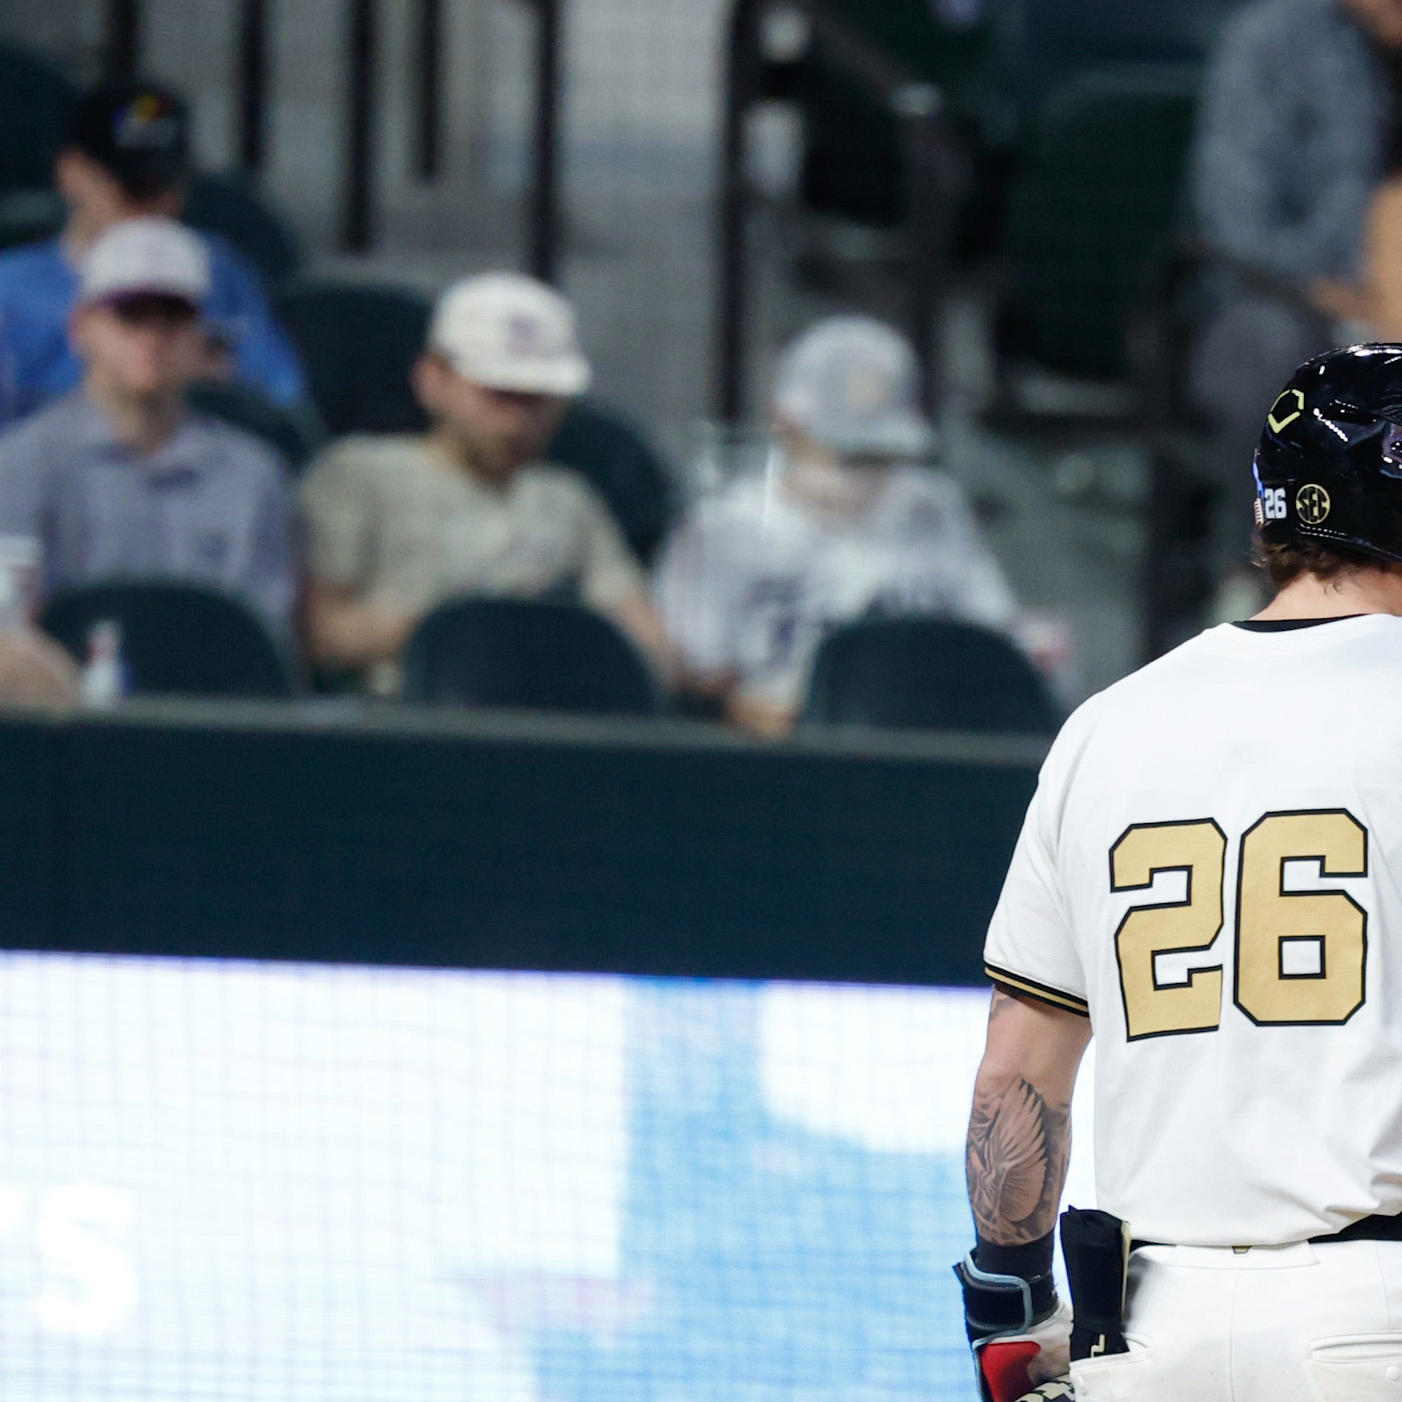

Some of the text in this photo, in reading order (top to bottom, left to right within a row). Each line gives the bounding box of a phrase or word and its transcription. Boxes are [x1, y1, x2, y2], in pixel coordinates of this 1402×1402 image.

[1264, 487, 1287, 519] 26
[1296, 486, 1331, 522] SEC
[1108, 808, 1368, 1042] 26
